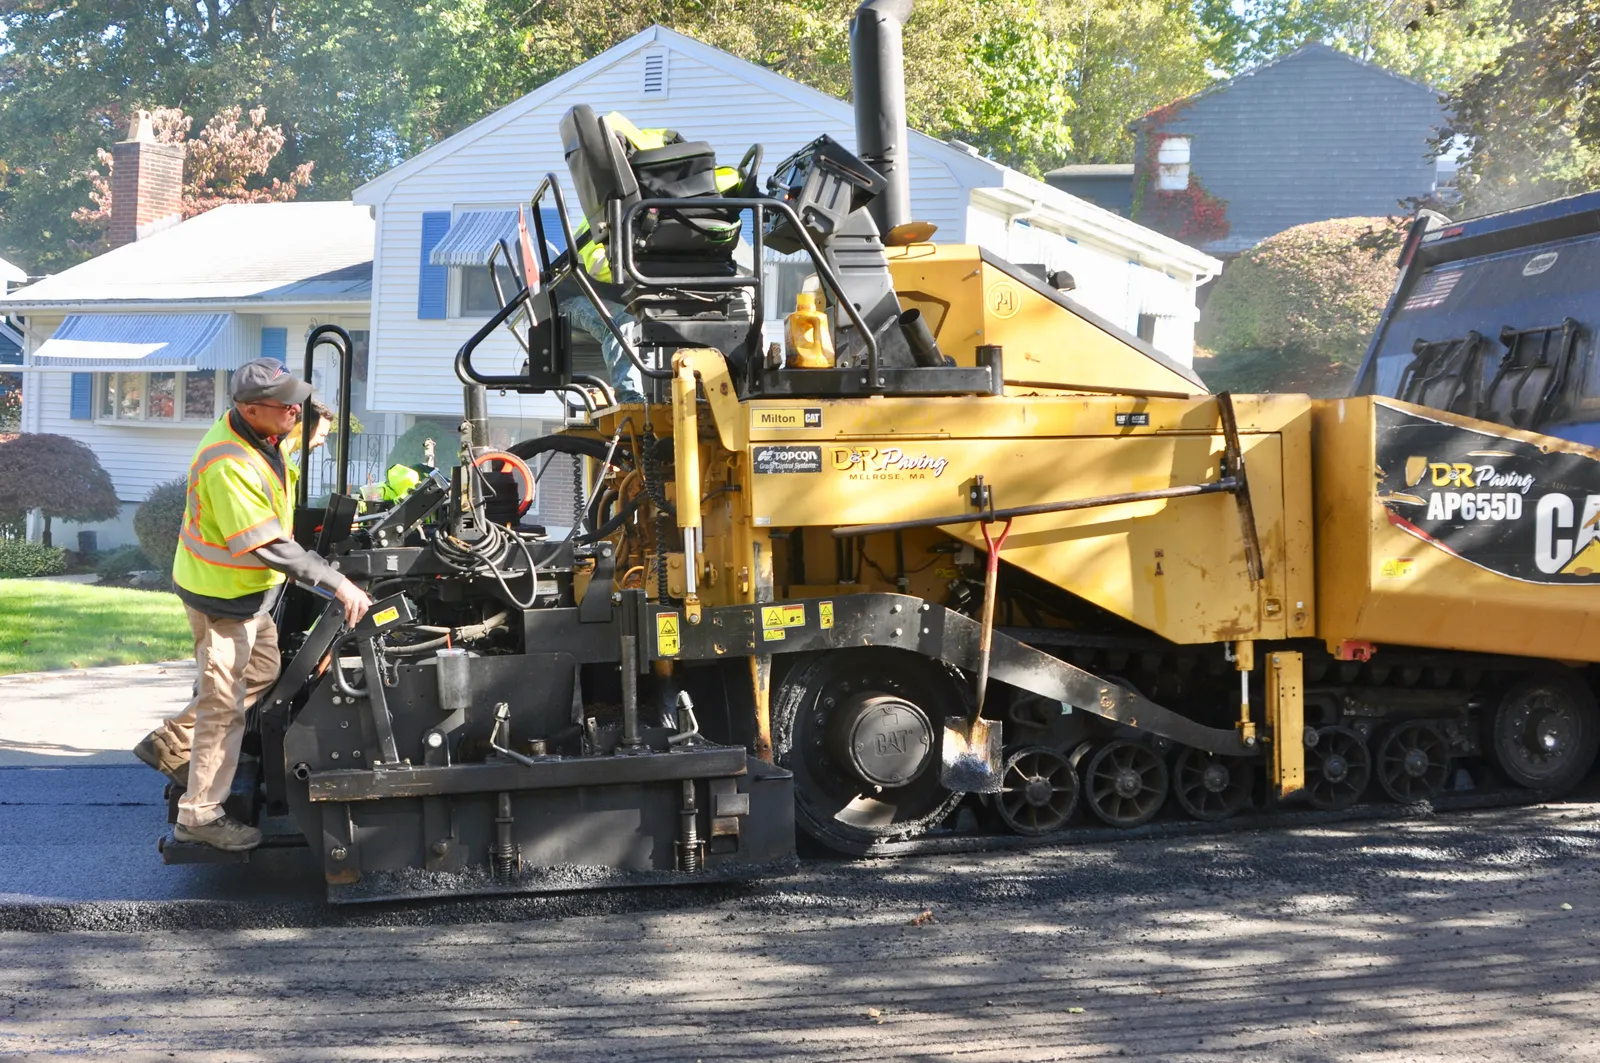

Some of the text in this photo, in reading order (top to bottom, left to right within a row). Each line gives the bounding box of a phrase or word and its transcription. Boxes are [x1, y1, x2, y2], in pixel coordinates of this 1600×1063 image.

[761, 413, 820, 423] Milton CAT
[773, 451, 818, 461] TOPCON
[829, 446, 949, 478] D&R Paving
[1429, 462, 1535, 494] D&R Paving
[1427, 492, 1523, 521] AP655D
[875, 730, 909, 756] CAT
